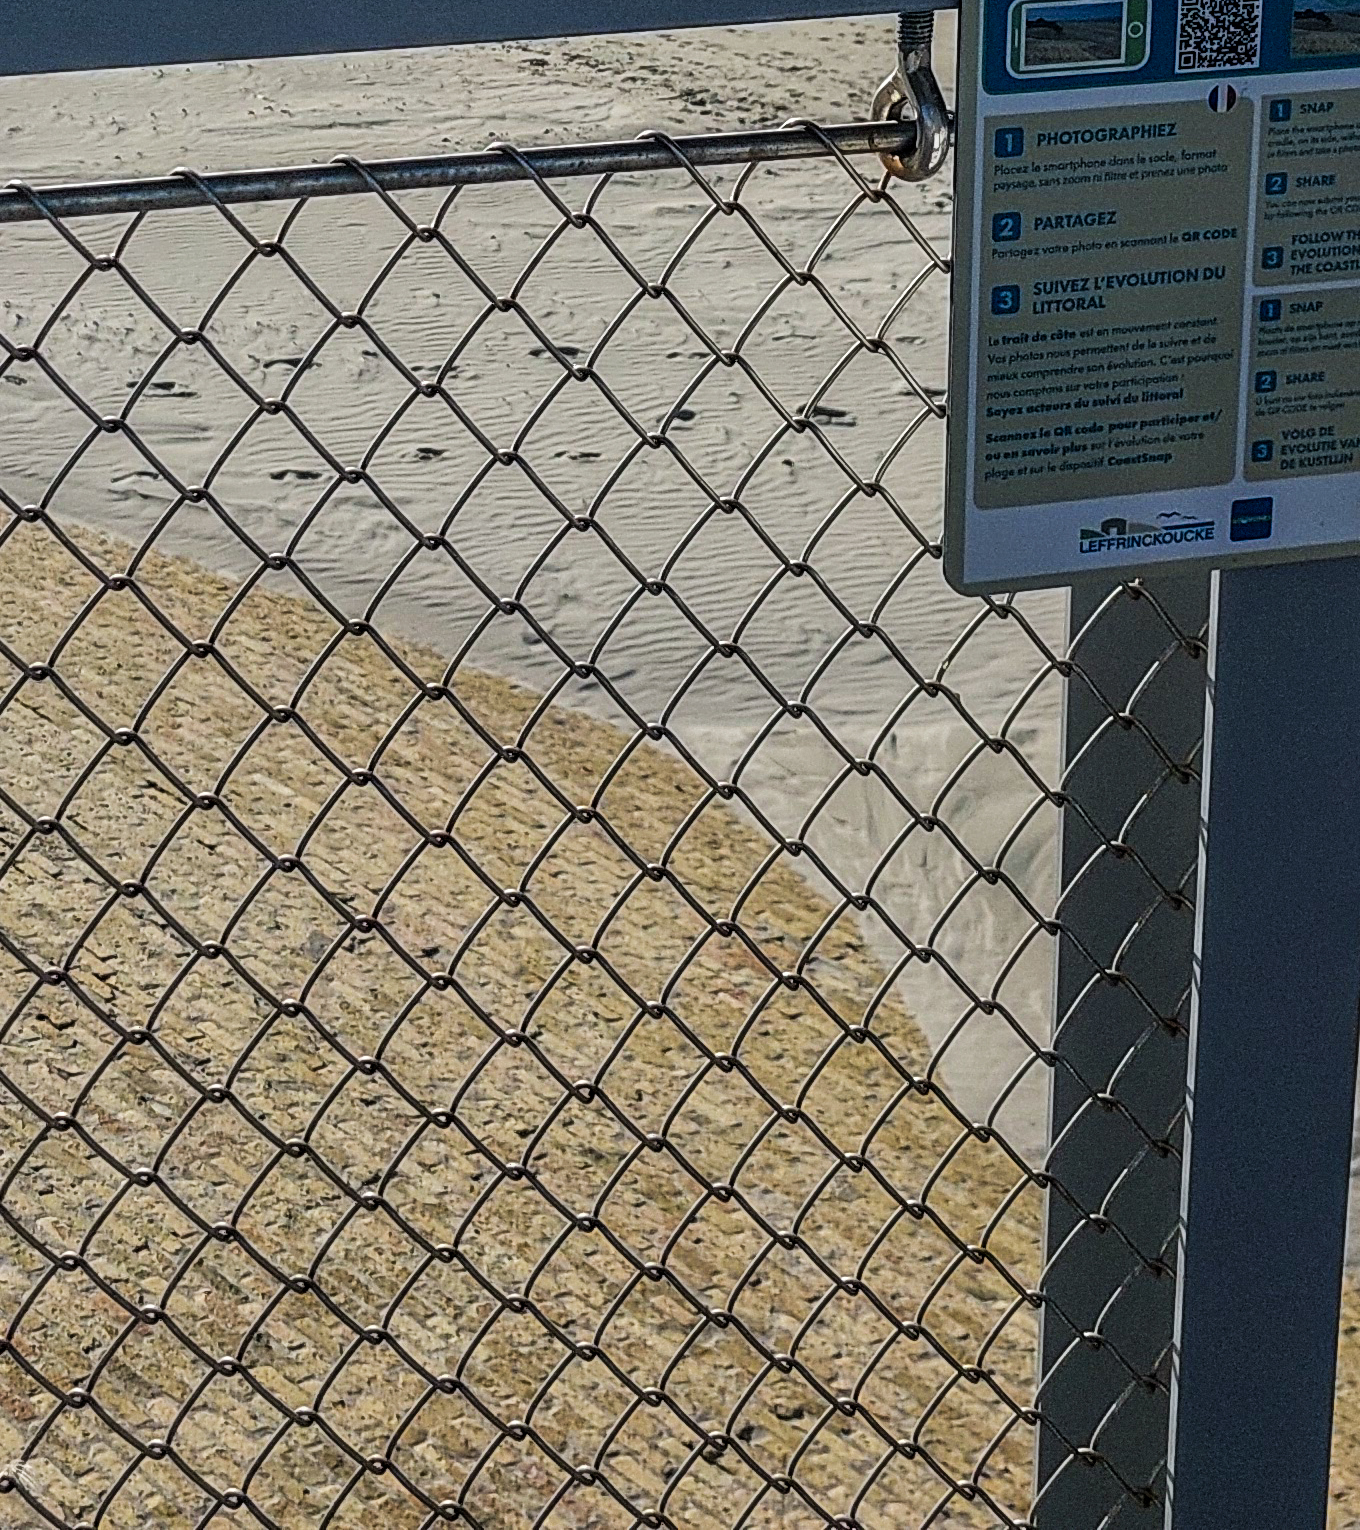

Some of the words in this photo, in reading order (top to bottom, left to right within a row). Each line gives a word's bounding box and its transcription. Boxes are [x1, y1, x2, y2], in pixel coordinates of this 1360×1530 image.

[1277, 103, 1284, 117] 1
[1299, 102, 1334, 115] SNAP
[1005, 133, 1013, 152] 1
[1037, 122, 1177, 147] PHOTOGRAPHIEZ
[994, 164, 1028, 176] Placez
[1043, 157, 1106, 172] smartphone
[1108, 155, 1134, 166] dans
[1181, 149, 1216, 161] format
[1039, 177, 1060, 187] sans
[1062, 175, 1090, 185] zoom
[1129, 170, 1139, 180] et
[1141, 168, 1175, 181] prenez
[1177, 166, 1196, 176] une
[1198, 163, 1228, 175] photo
[1270, 177, 1282, 190] 2
[1295, 174, 1336, 188] SHARE
[999, 218, 1013, 236] 2
[1034, 211, 1116, 231] PARTAGEZ
[992, 248, 1039, 259] Partagez
[1041, 244, 1068, 255] votre
[1071, 240, 1102, 254] photo
[1120, 235, 1167, 248] scannant
[1170, 232, 1179, 244] le
[1182, 231, 1200, 242] QR
[1203, 228, 1237, 240] CODE
[1291, 231, 1346, 246] FOLLOW
[1267, 251, 1277, 265] 3
[1291, 245, 1360, 260] EVOLUTION
[1033, 277, 1090, 296] SUIVEZ
[1094, 268, 1199, 291] L'EVOLUTION
[1203, 265, 1227, 280] DU
[1290, 263, 1312, 276] THE
[998, 290, 1013, 309] 3
[1032, 296, 1106, 315] LITTORAL
[1289, 301, 1323, 314] SNAP
[988, 335, 1000, 347] Le
[1001, 332, 1029, 345] trait
[1031, 331, 1048, 342] de
[1050, 329, 1076, 340] côte
[1096, 328, 1109, 337] en
[1111, 321, 1171, 334] mouvement
[1009, 351, 1044, 364] photos
[1046, 349, 1071, 359] nous
[1072, 342, 1129, 358] permettent
[1131, 339, 1145, 351] de
[1159, 336, 1189, 348] suivre
[1191, 335, 1201, 345] et
[1203, 333, 1217, 344] de
[987, 372, 1018, 382] mieux
[1020, 364, 1085, 379] comprendre
[1086, 364, 1105, 372] son
[1187, 349, 1235, 365] pourquoi
[986, 390, 1011, 400] nous
[1013, 385, 1063, 397] comptons
[1065, 383, 1080, 392] sur
[1083, 380, 1109, 390] votre
[1112, 373, 1178, 390] participation
[1260, 375, 1272, 389] 2
[1285, 371, 1325, 385] SHARE
[986, 406, 1023, 419] Soyez
[1026, 402, 1071, 413] acteurs
[1074, 397, 1090, 408] du
[1092, 393, 1120, 406] suivi
[1123, 392, 1139, 404] du
[1141, 387, 1184, 402] littoral
[986, 431, 1037, 444] Scannez
[1039, 427, 1051, 438] le
[1054, 425, 1072, 436] QR
[1075, 422, 1104, 435] code
[1108, 421, 1138, 433] pour
[1140, 413, 1200, 430] participer
[1281, 427, 1316, 440] VOLG
[1319, 425, 1334, 436] DE
[985, 452, 1000, 461] ou
[1003, 450, 1019, 459] en
[1022, 443, 1060, 457] savoir
[1062, 441, 1088, 456] plus
[1091, 441, 1106, 450] sur
[1162, 433, 1176, 443] de
[1178, 431, 1205, 440] votre
[1256, 443, 1267, 458] 3
[1280, 440, 1337, 455] EVOLUTIE
[985, 467, 1015, 482] plage
[1017, 466, 1027, 475] et
[1029, 465, 1044, 474] sur
[1047, 461, 1056, 472] le
[1059, 456, 1104, 472] dispositif
[1107, 453, 1173, 466] CoastSnap
[1280, 459, 1296, 471] DE
[1298, 453, 1353, 469] KUSTLIJN
[1079, 527, 1215, 553] LEFFRINCKOUCKE
